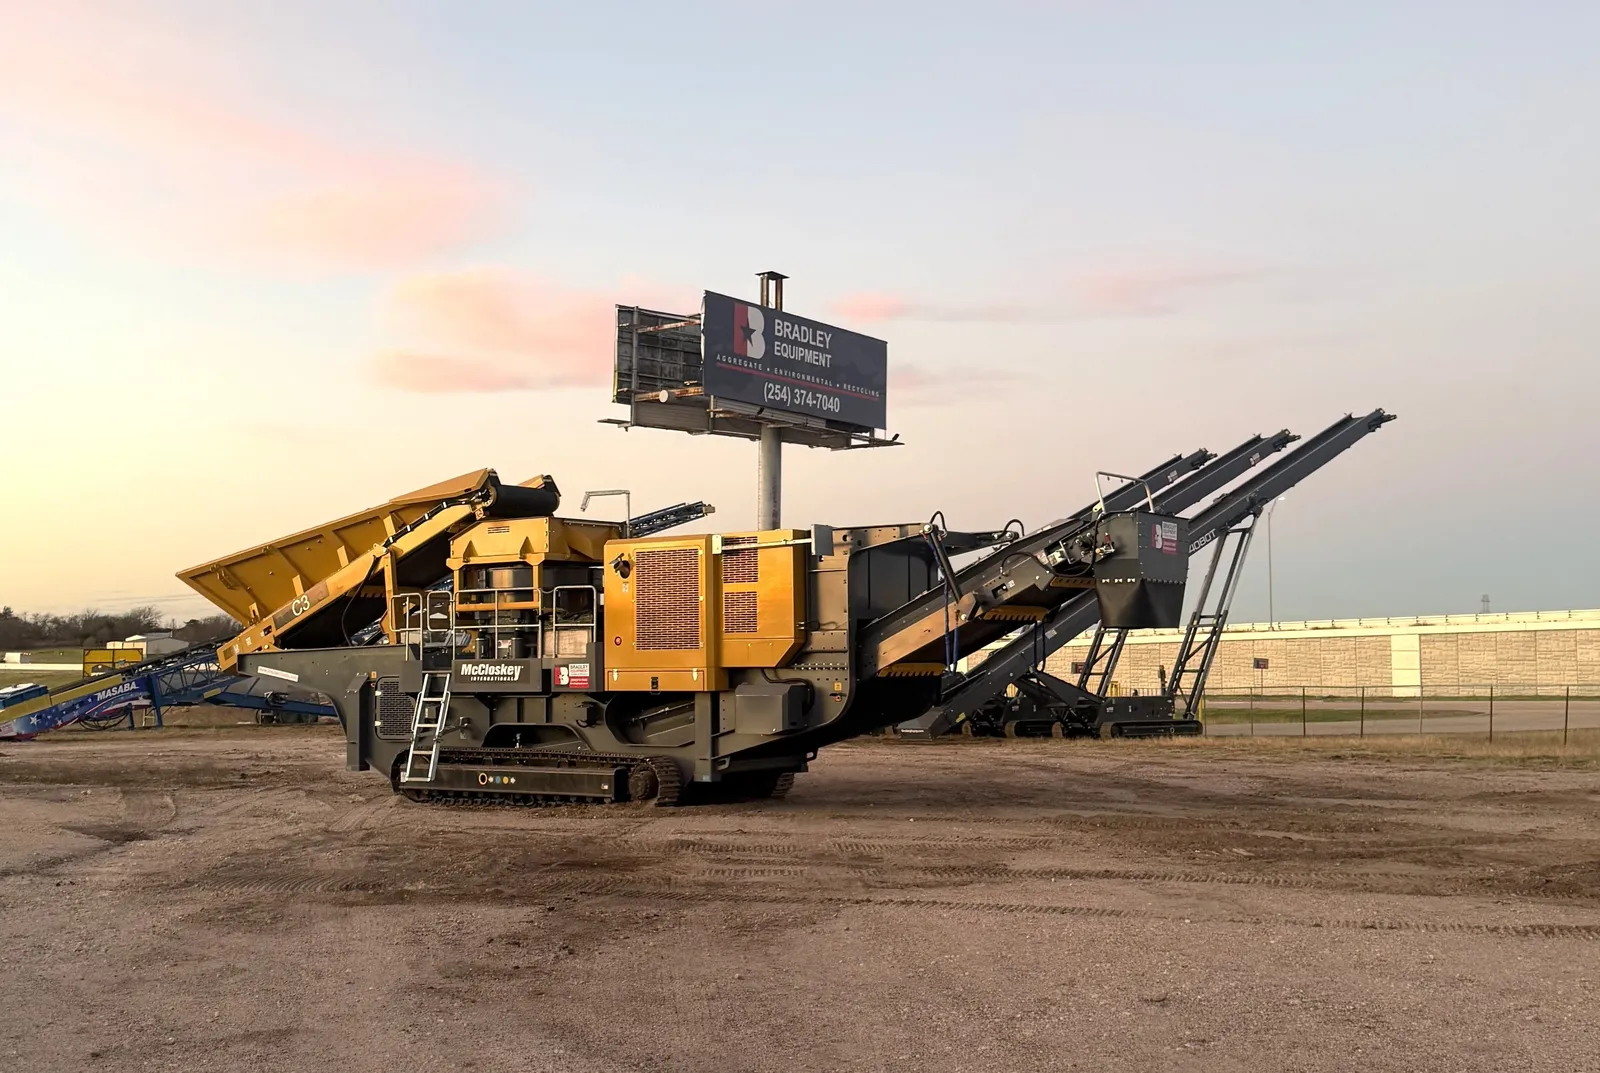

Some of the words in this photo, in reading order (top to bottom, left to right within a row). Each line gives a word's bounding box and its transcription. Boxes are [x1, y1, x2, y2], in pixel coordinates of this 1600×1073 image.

[774, 318, 832, 350] BRADLEY
[774, 341, 832, 368] EQUIPMENT
[716, 353, 763, 371] AGGREGATE
[774, 367, 833, 387] ENVIRONMENTAL
[843, 383, 880, 398] RECYCLING
[763, 381, 792, 406] (254)
[794, 388, 840, 413] 374-7040
[292, 594, 310, 616] C3
[460, 663, 522, 682] McCloskey
[94, 681, 140, 702] MASABA
